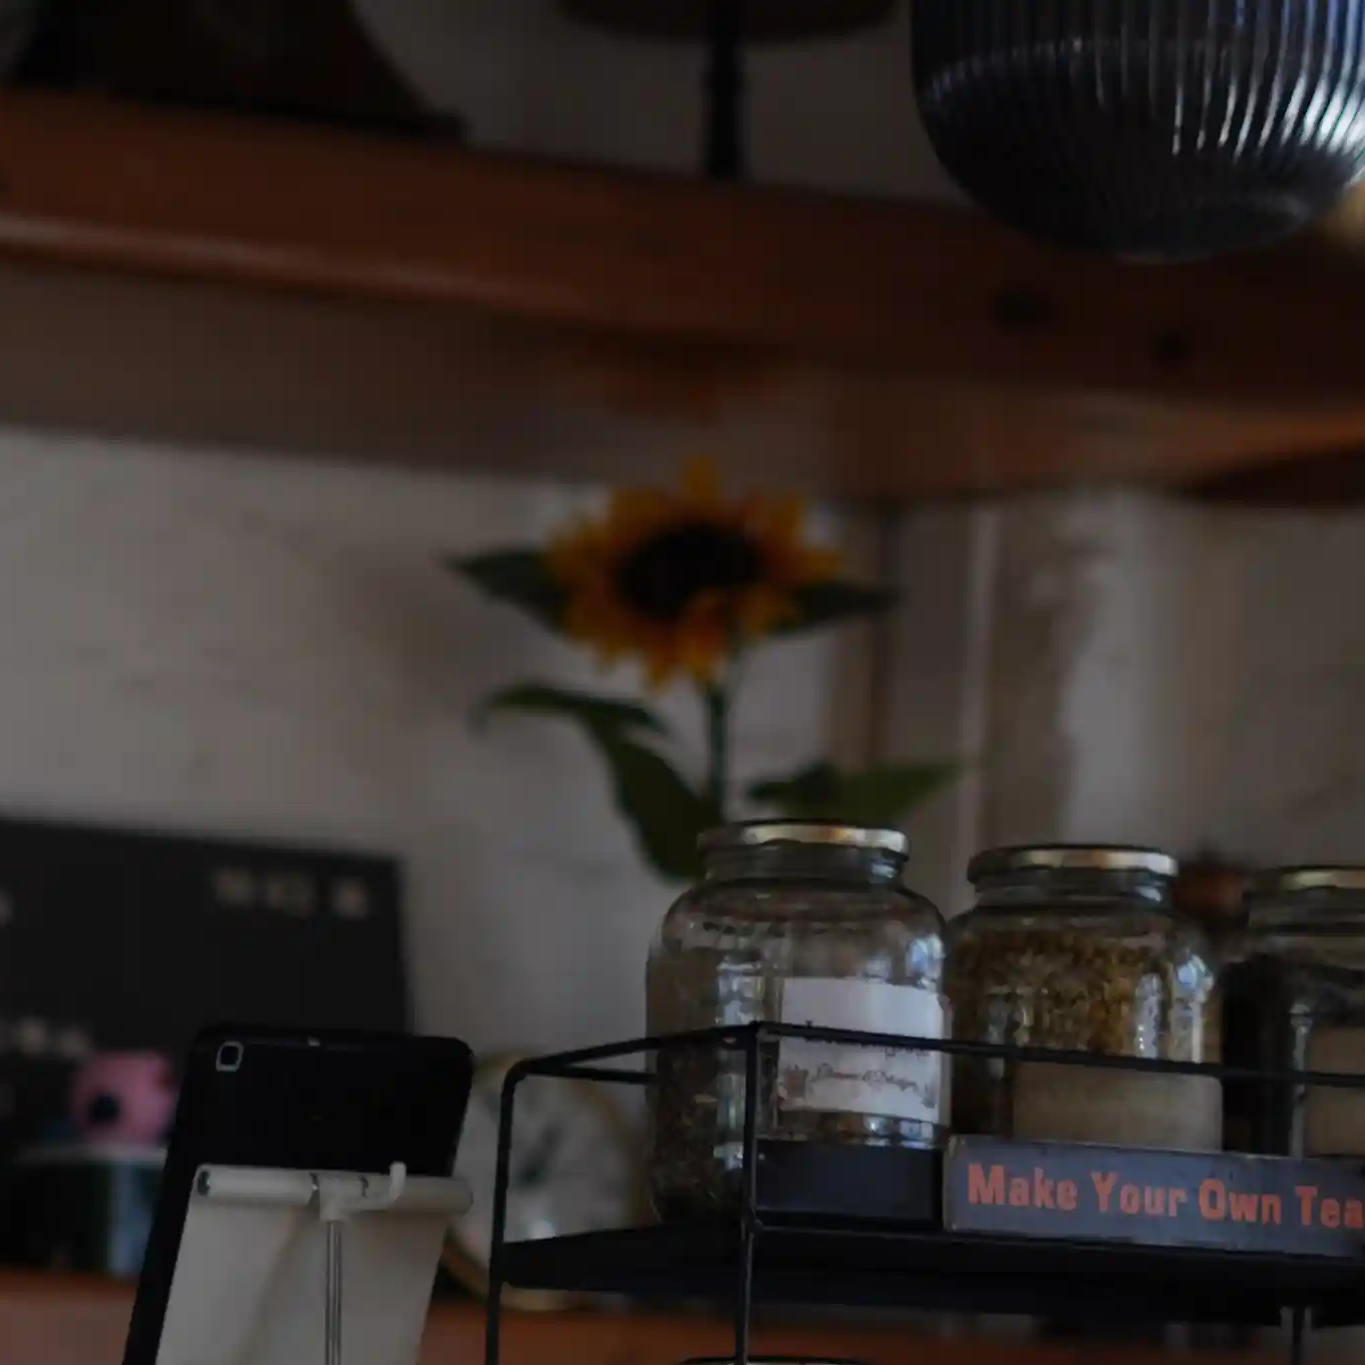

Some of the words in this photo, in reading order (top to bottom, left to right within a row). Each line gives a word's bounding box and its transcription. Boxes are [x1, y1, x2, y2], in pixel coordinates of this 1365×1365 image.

[967, 1163, 1078, 1211] Make
[1090, 1170, 1188, 1218] Your
[1198, 1177, 1282, 1226] Own
[1295, 1184, 1365, 1230] Tea
